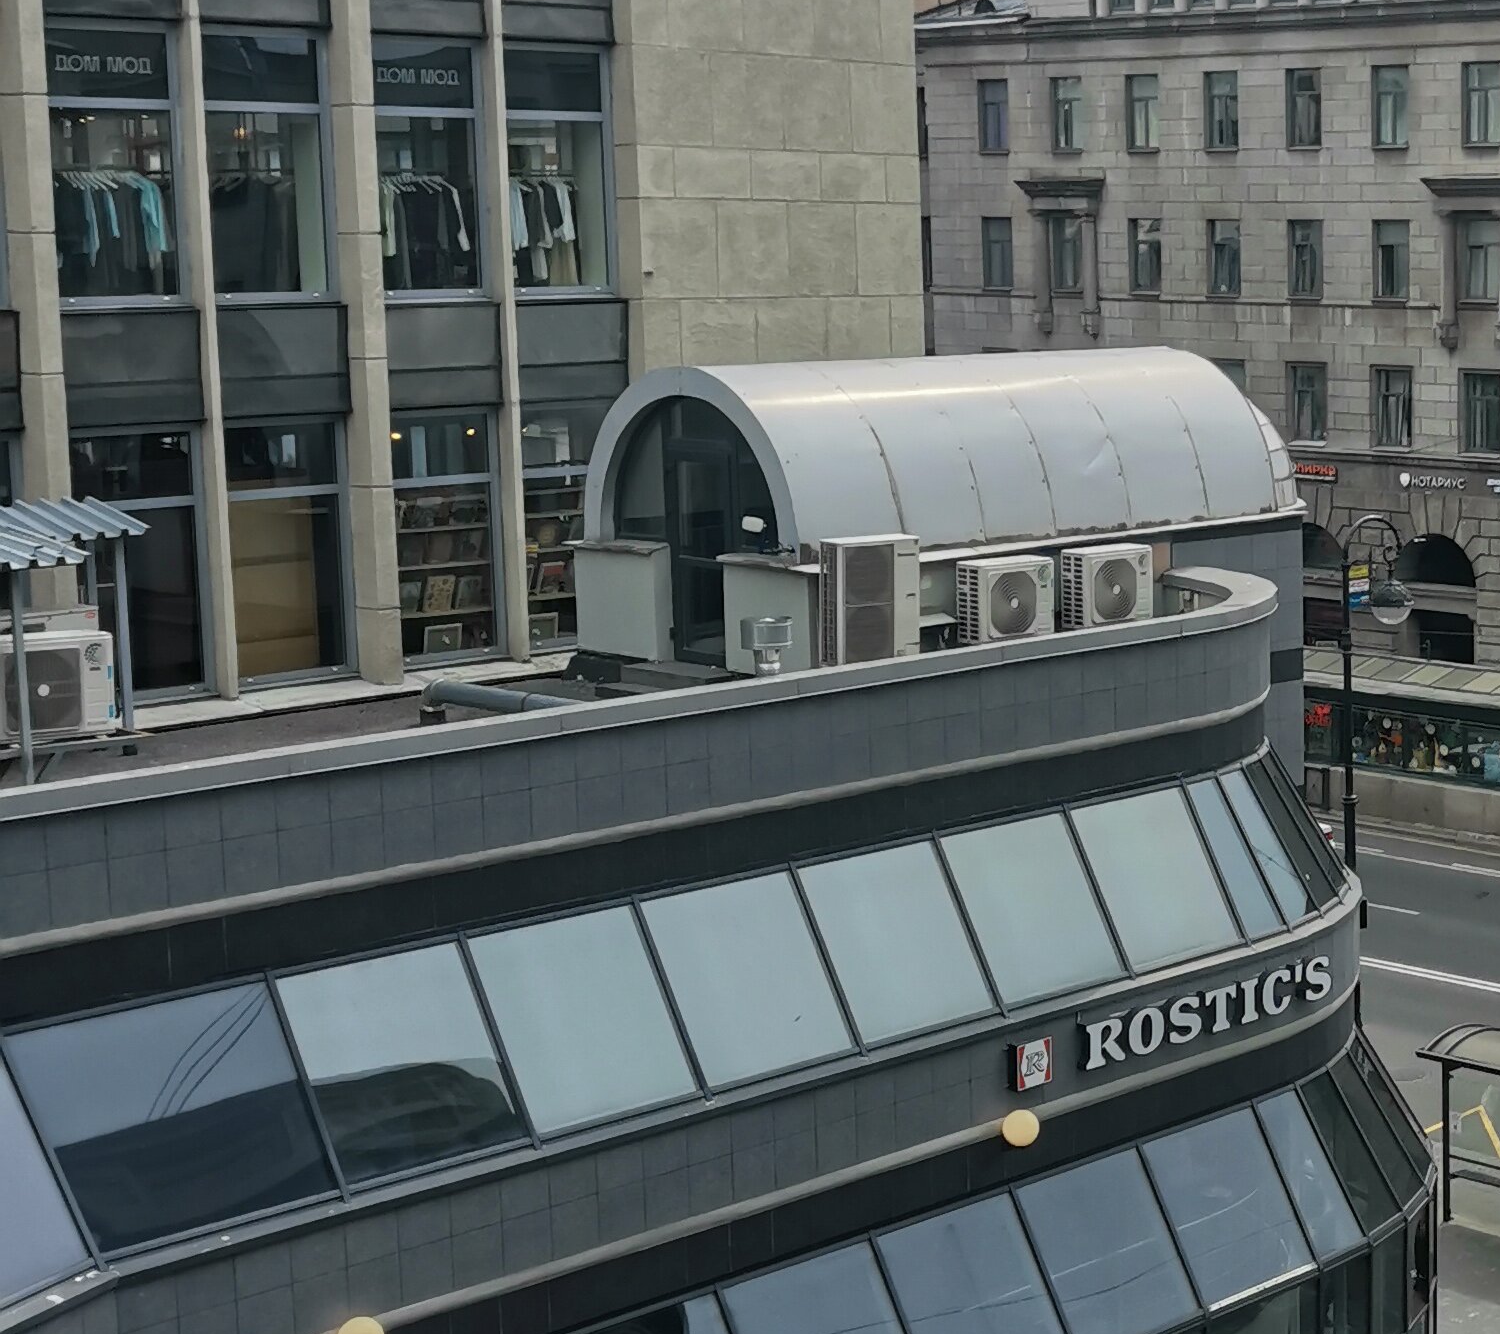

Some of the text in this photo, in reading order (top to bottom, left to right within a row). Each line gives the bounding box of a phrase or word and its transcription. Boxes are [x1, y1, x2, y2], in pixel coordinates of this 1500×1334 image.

[54, 54, 153, 74] ДОМ МОД
[376, 67, 460, 85] ДОМ МОД
[1411, 475, 1466, 490] НОТАРИУС
[1084, 955, 1332, 1071] ROSTIC'S
